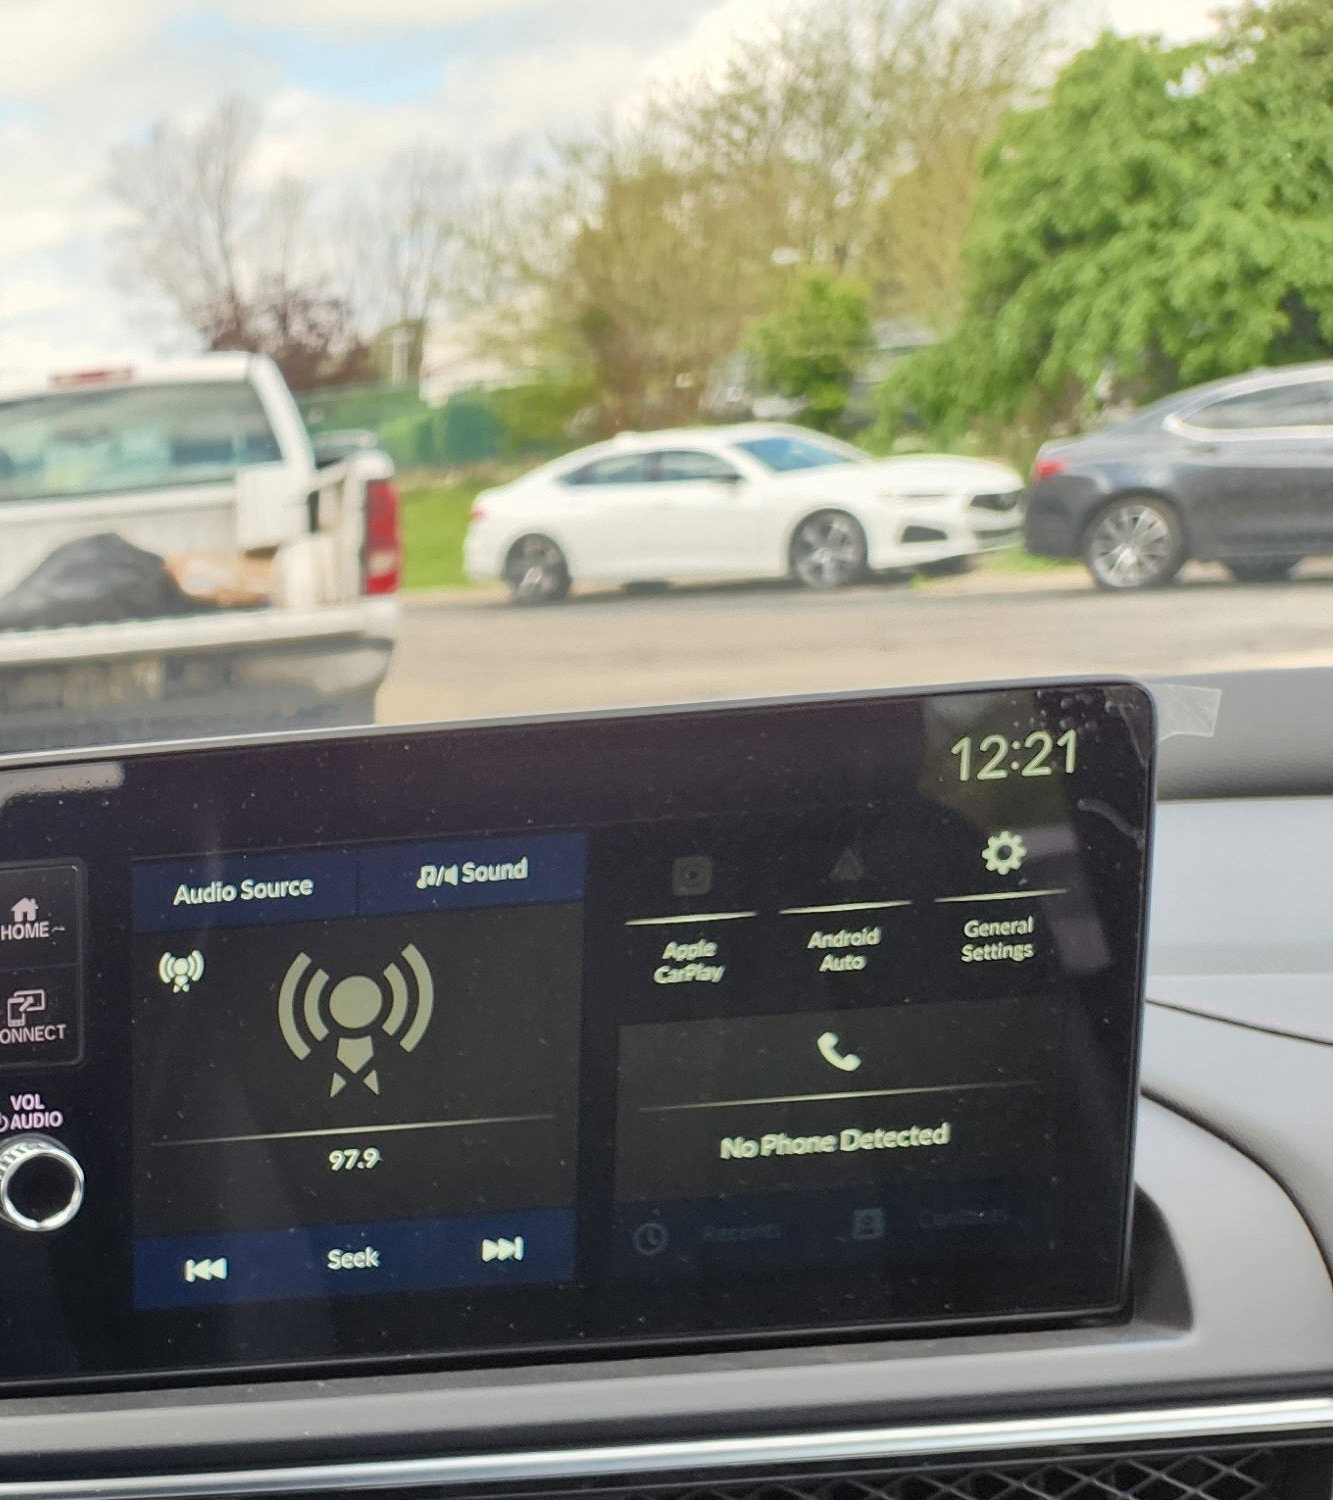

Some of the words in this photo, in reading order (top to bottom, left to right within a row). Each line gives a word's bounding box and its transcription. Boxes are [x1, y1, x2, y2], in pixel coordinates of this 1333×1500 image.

[951, 729, 1076, 782] 12:21
[461, 856, 529, 883] Sound
[173, 881, 237, 906] Audio
[240, 877, 314, 901] Source
[0, 921, 50, 941] HOME
[807, 926, 881, 949] Android
[963, 915, 1034, 938] General
[662, 939, 717, 961] Apple
[961, 941, 1034, 963] Settings
[653, 960, 725, 985] CarPlay
[819, 953, 867, 973] Auto
[10, 1094, 46, 1112] VOL
[10, 1111, 64, 1131] AUDIO
[720, 1136, 757, 1160] No
[760, 1132, 838, 1157] Phone
[839, 1122, 950, 1153] Detected
[328, 1147, 381, 1171] 97.9
[327, 1246, 380, 1270] Seek
